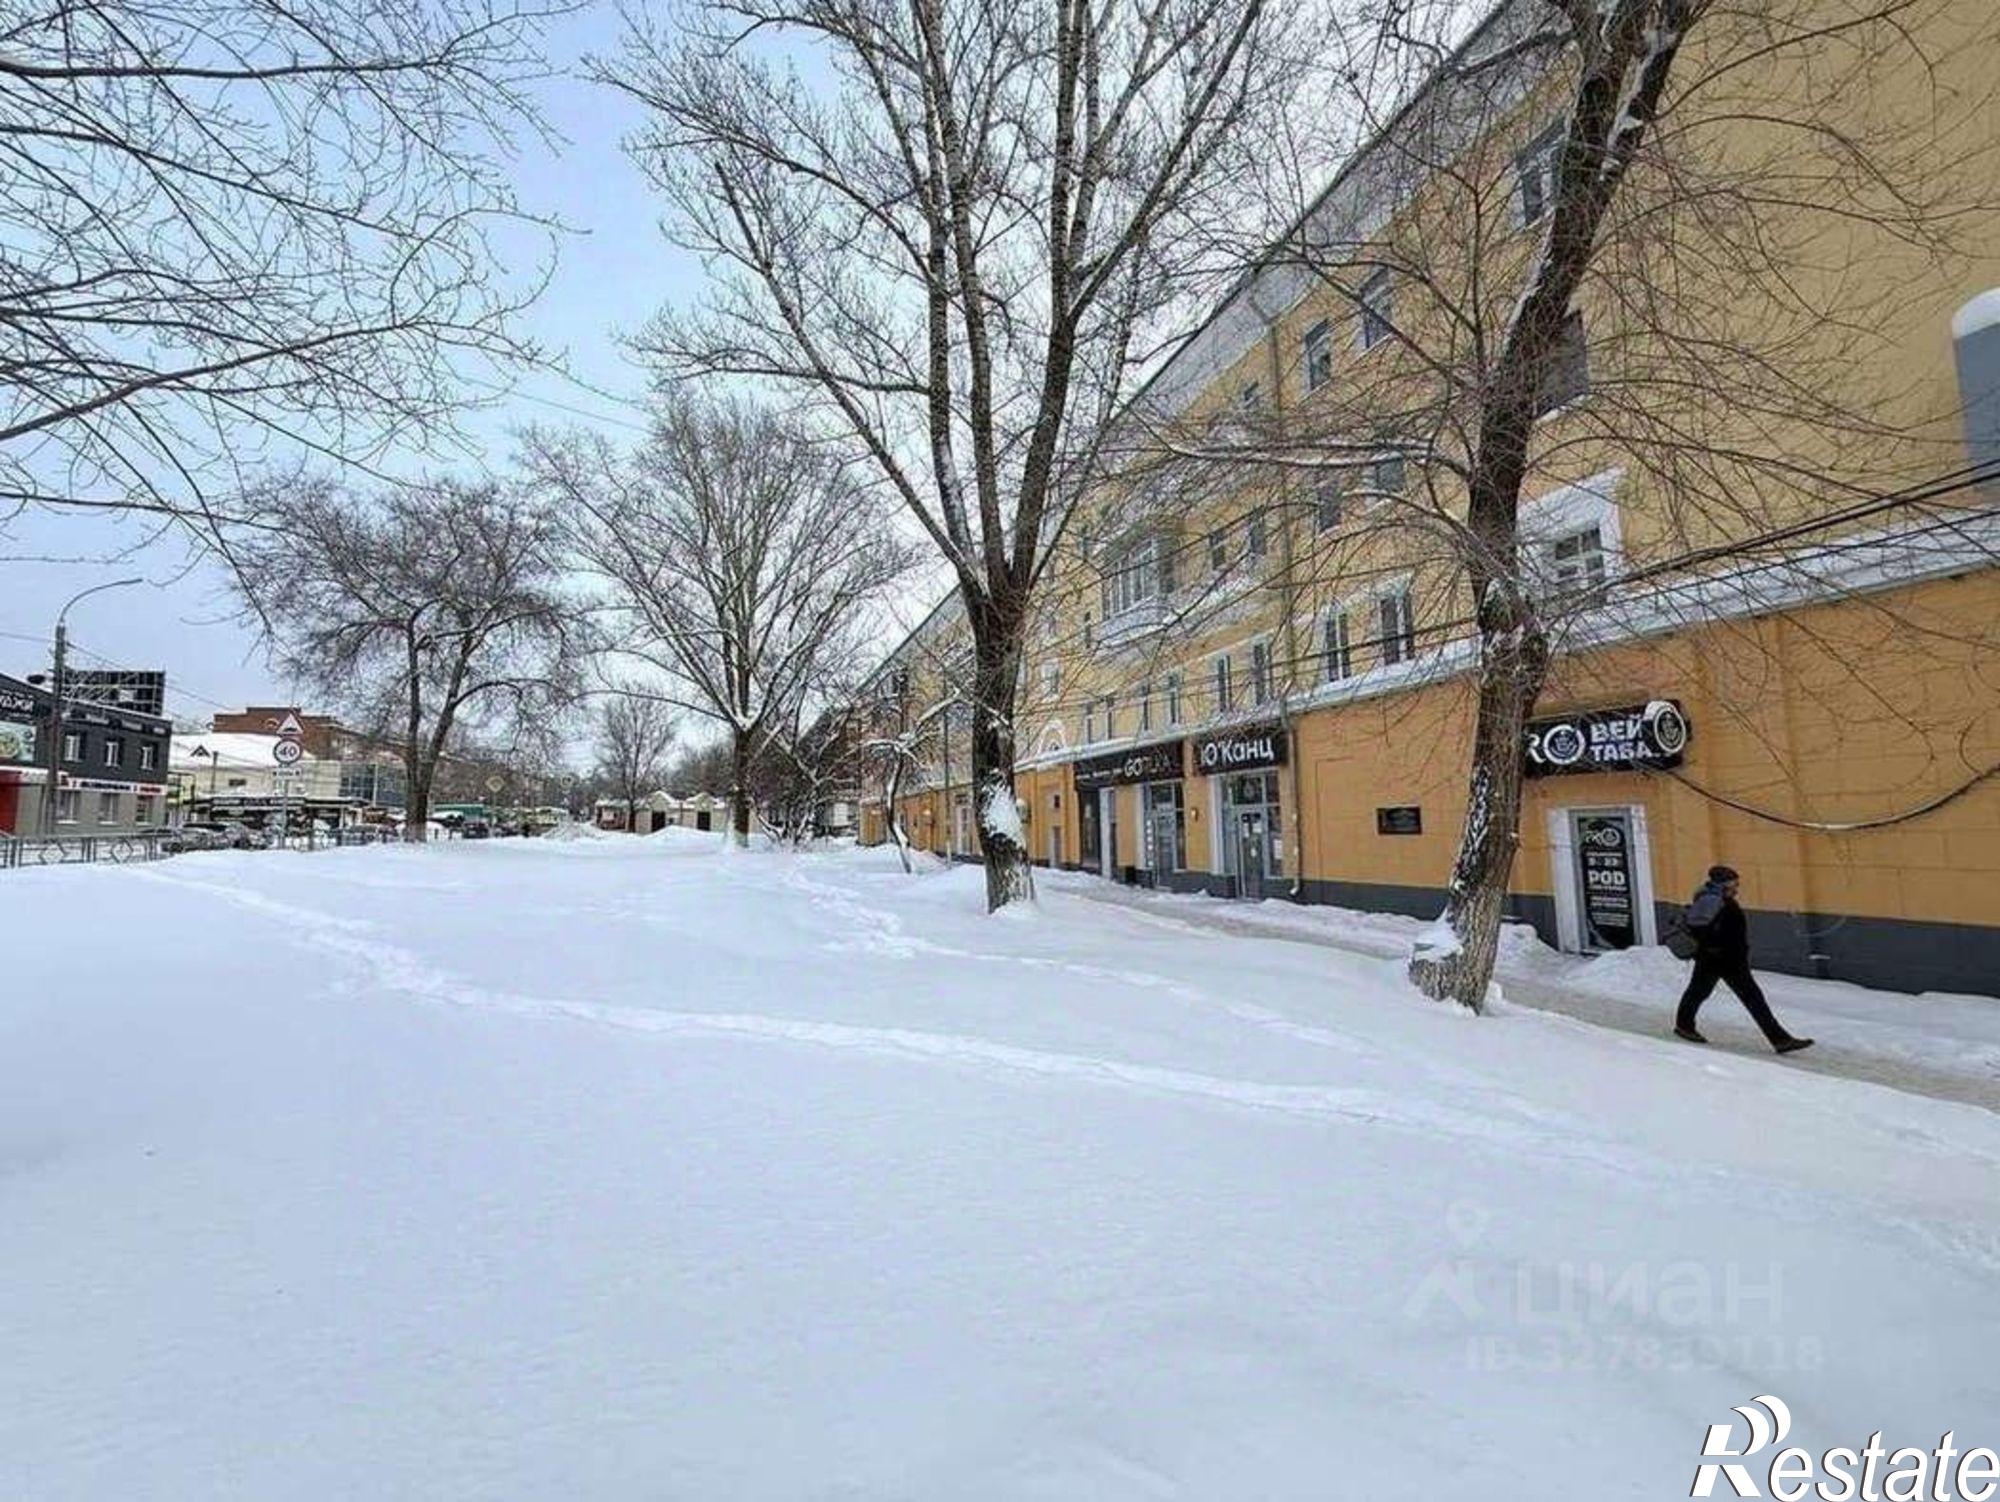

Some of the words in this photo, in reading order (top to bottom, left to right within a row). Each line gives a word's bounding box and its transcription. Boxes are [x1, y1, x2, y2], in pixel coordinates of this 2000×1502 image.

[1590, 714, 1645, 741] ВЕЙ
[279, 745, 298, 758] 40
[1590, 739, 1666, 762] ТАБА
[1588, 871, 1626, 886] POD
